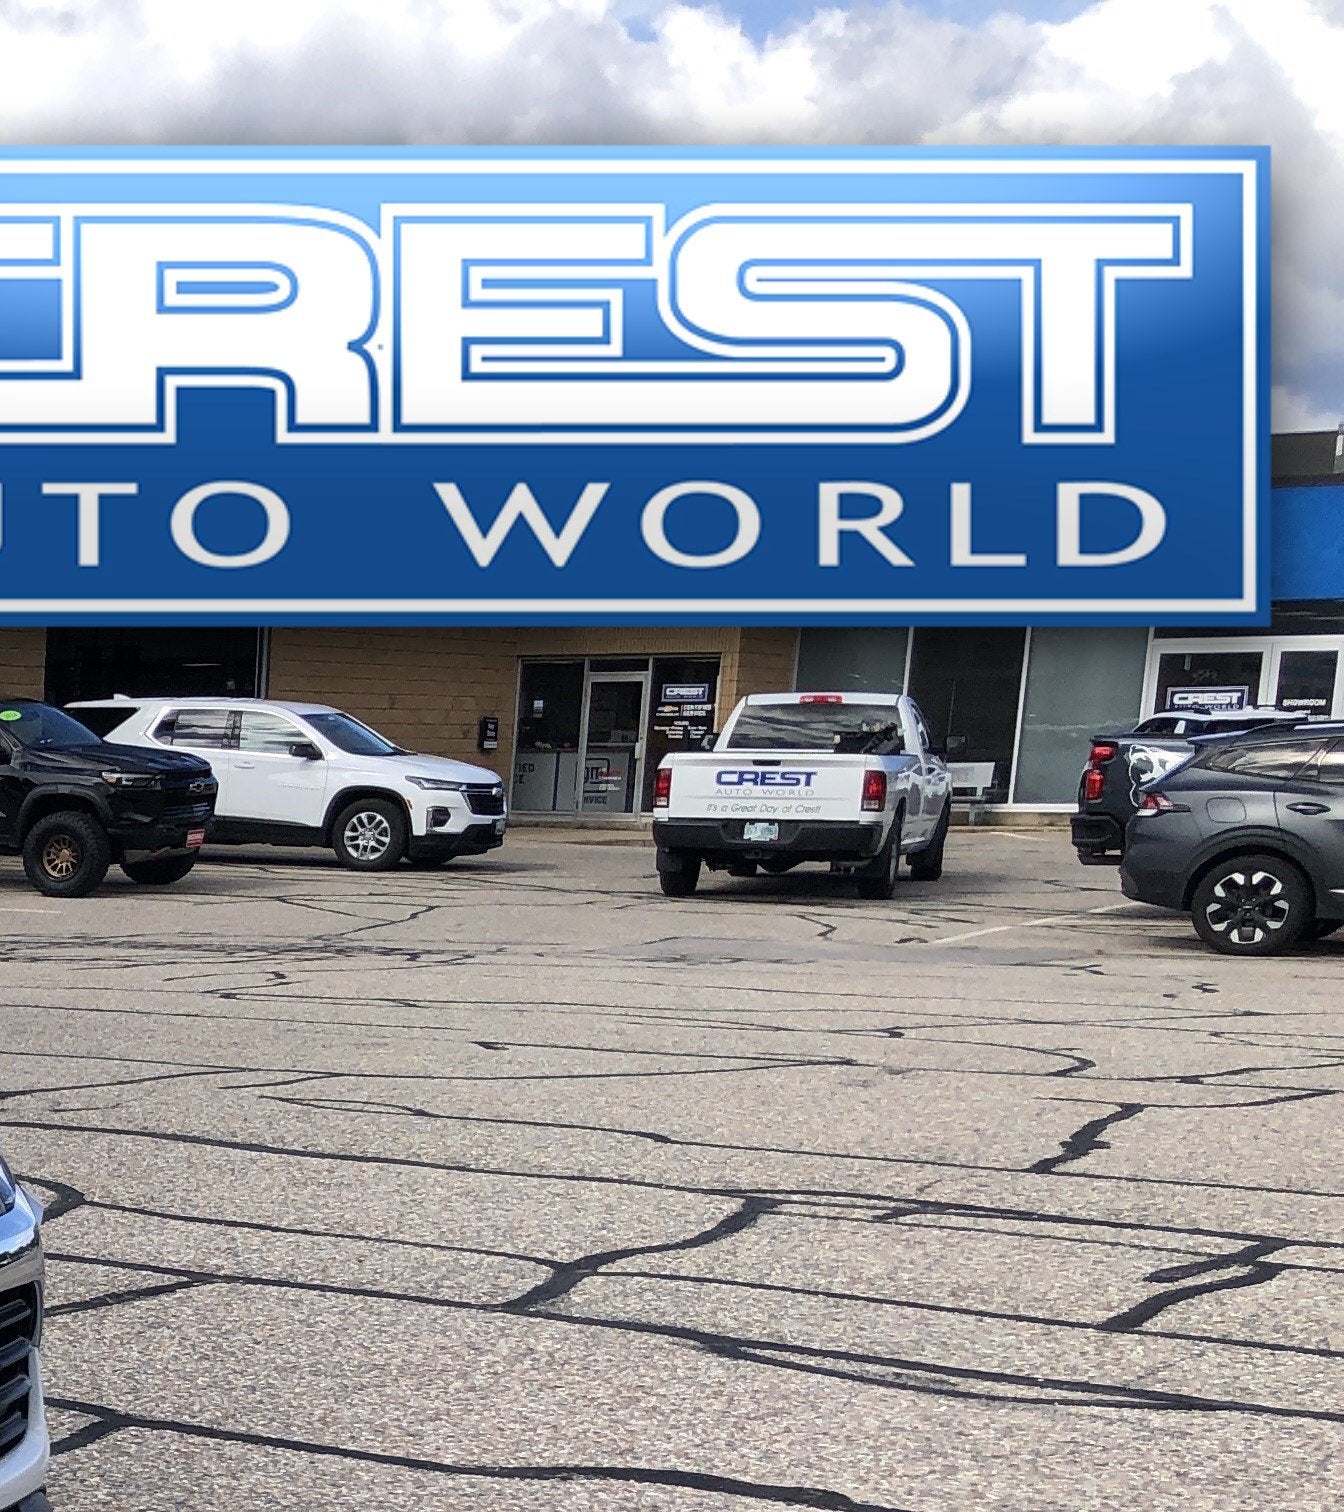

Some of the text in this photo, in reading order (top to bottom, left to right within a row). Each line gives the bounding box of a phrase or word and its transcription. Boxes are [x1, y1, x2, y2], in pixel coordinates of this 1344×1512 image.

[1172, 692, 1242, 705] CREST
[1282, 698, 1327, 707] SHOWROOM
[715, 770, 818, 787] CREST
[714, 788, 815, 796] AUTO WORLD
[720, 804, 729, 812] a
[731, 803, 758, 812] Great
[759, 803, 779, 814] Day
